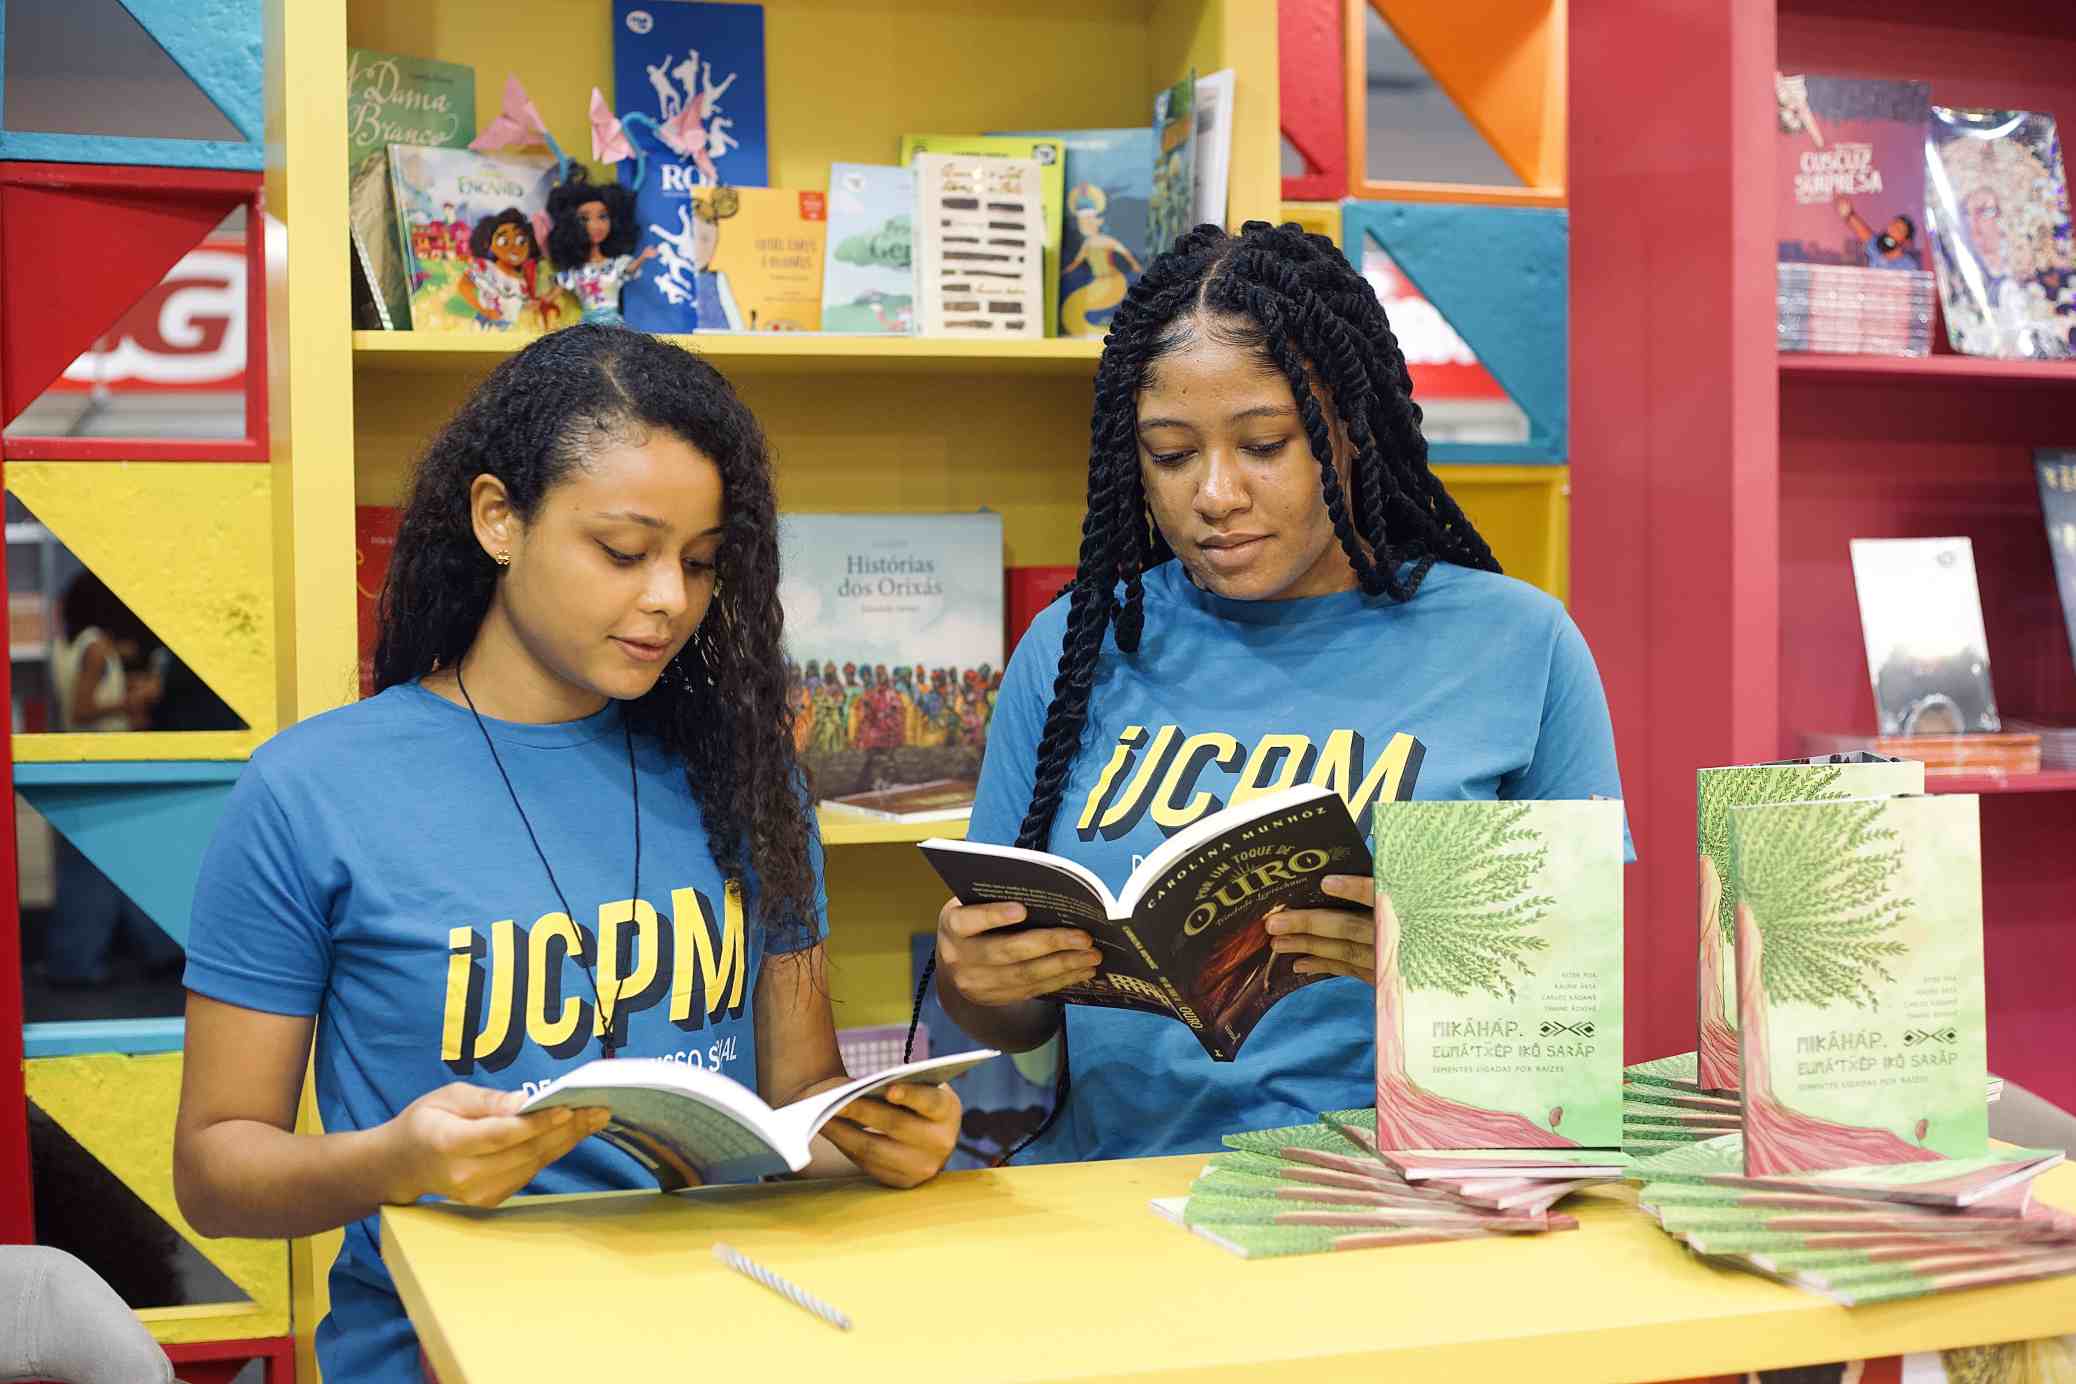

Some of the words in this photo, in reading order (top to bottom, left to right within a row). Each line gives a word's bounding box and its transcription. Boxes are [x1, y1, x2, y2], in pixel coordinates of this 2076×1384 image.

[847, 553, 935, 575] Histórias
[837, 576, 873, 598] dos
[877, 575, 944, 598] Orixás
[1147, 842, 1231, 909] CAROLINA
[1241, 806, 1327, 841] MUNHÓZ
[1232, 843, 1272, 864] TOQUE
[1183, 848, 1330, 937] OURO
